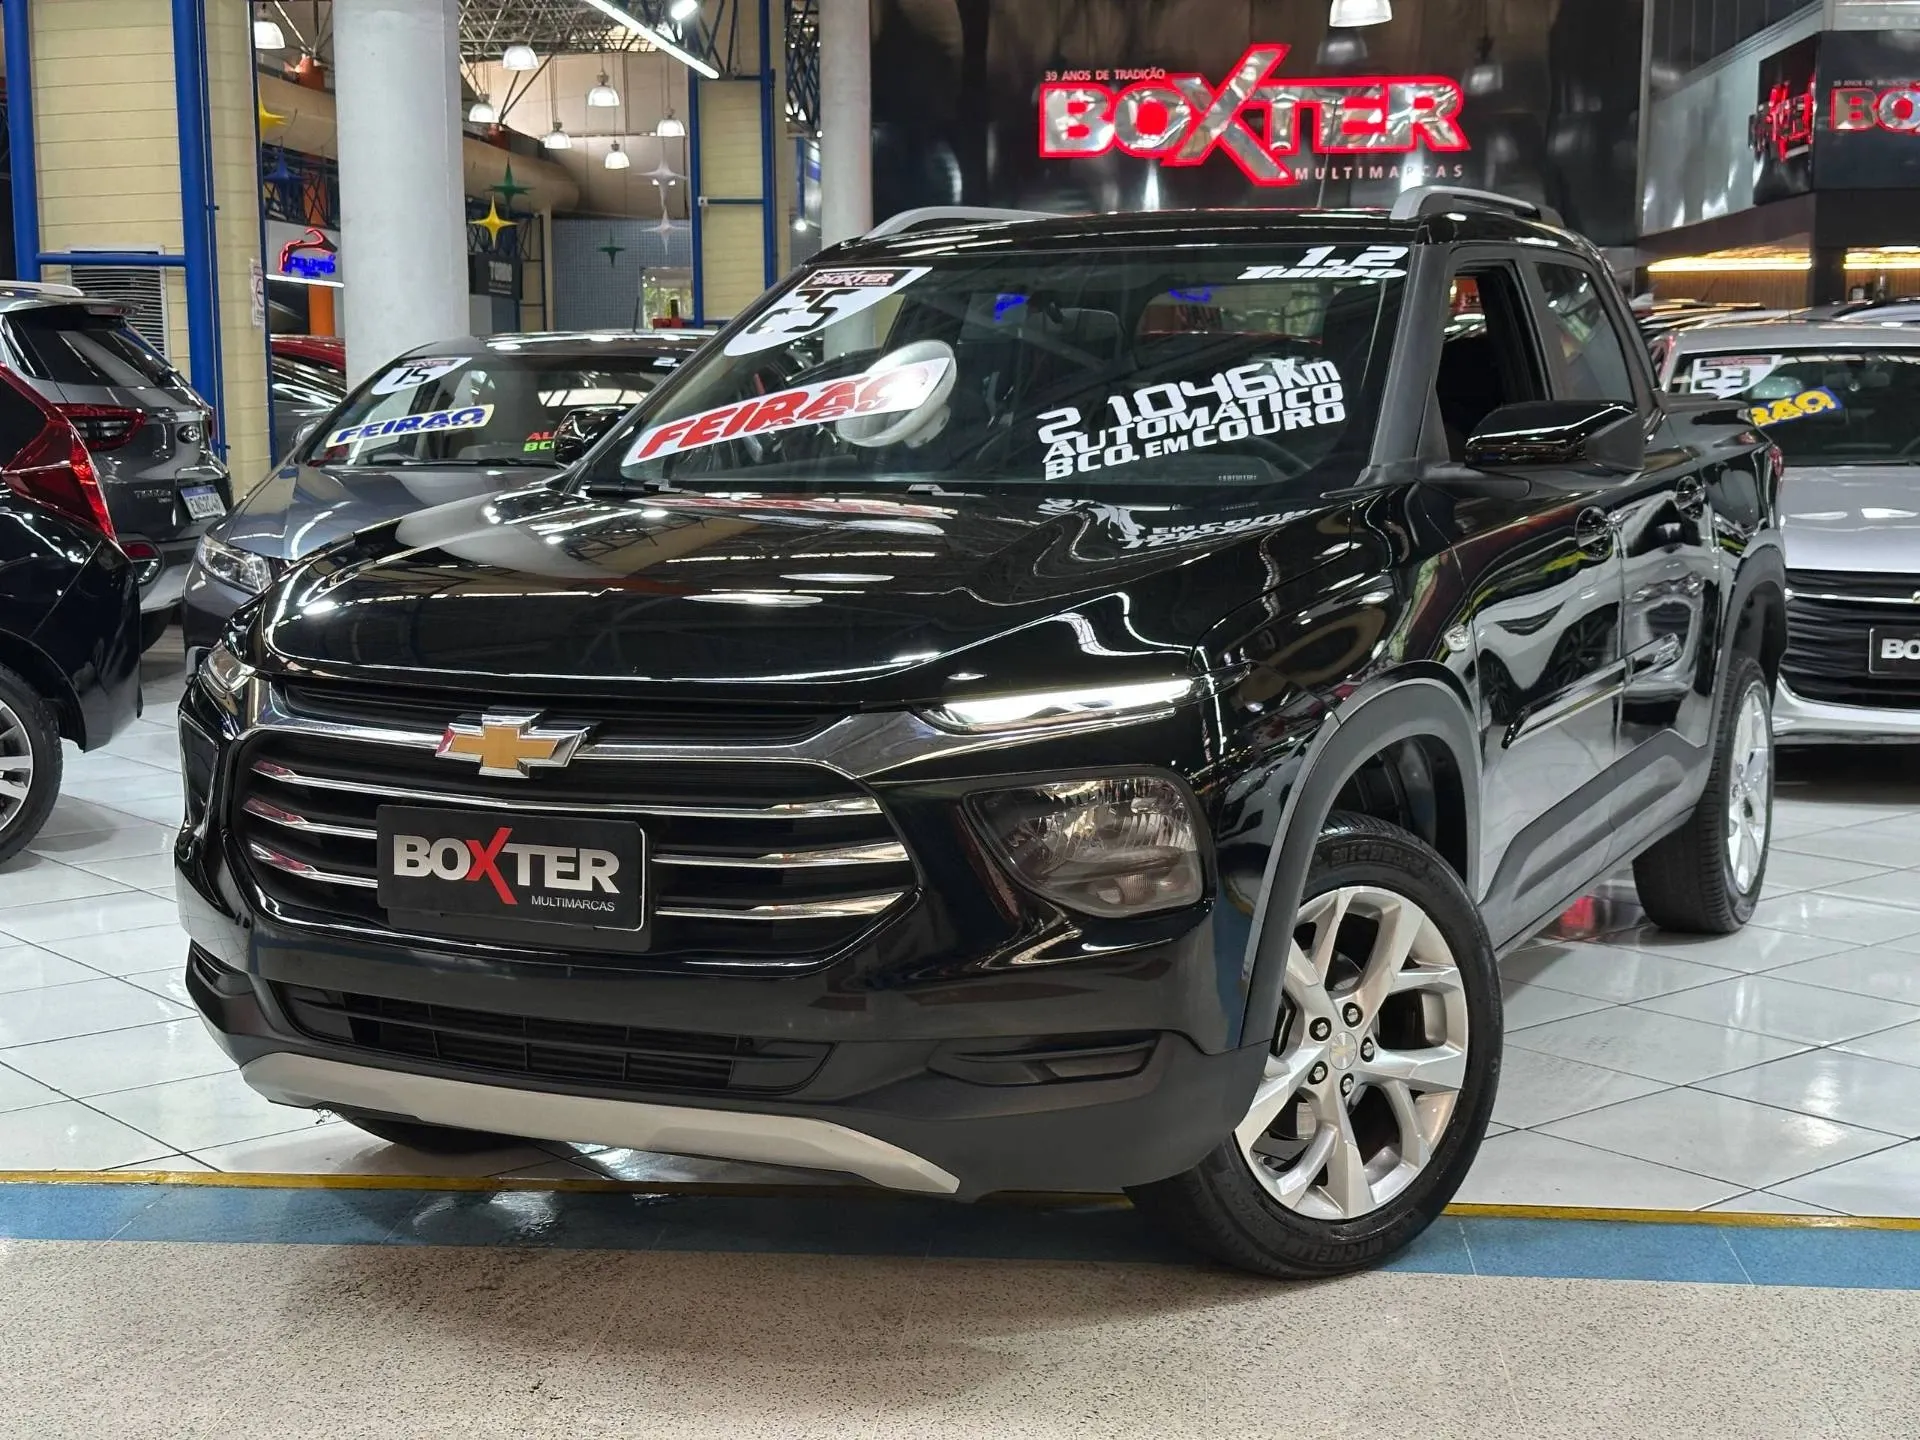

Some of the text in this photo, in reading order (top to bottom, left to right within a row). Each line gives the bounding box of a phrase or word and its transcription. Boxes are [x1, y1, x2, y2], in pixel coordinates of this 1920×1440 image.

[1045, 66, 1166, 81] 39 ANOS DE TRADIÇÃO
[1039, 44, 1471, 187] BOXTER
[1296, 245, 1409, 267] 1.2
[1694, 366, 1751, 391] 23
[1145, 438, 1189, 459] EM
[1192, 402, 1346, 448] COURO
[393, 827, 621, 905] BOXTER
[531, 894, 616, 913] MULTIMARCAS
